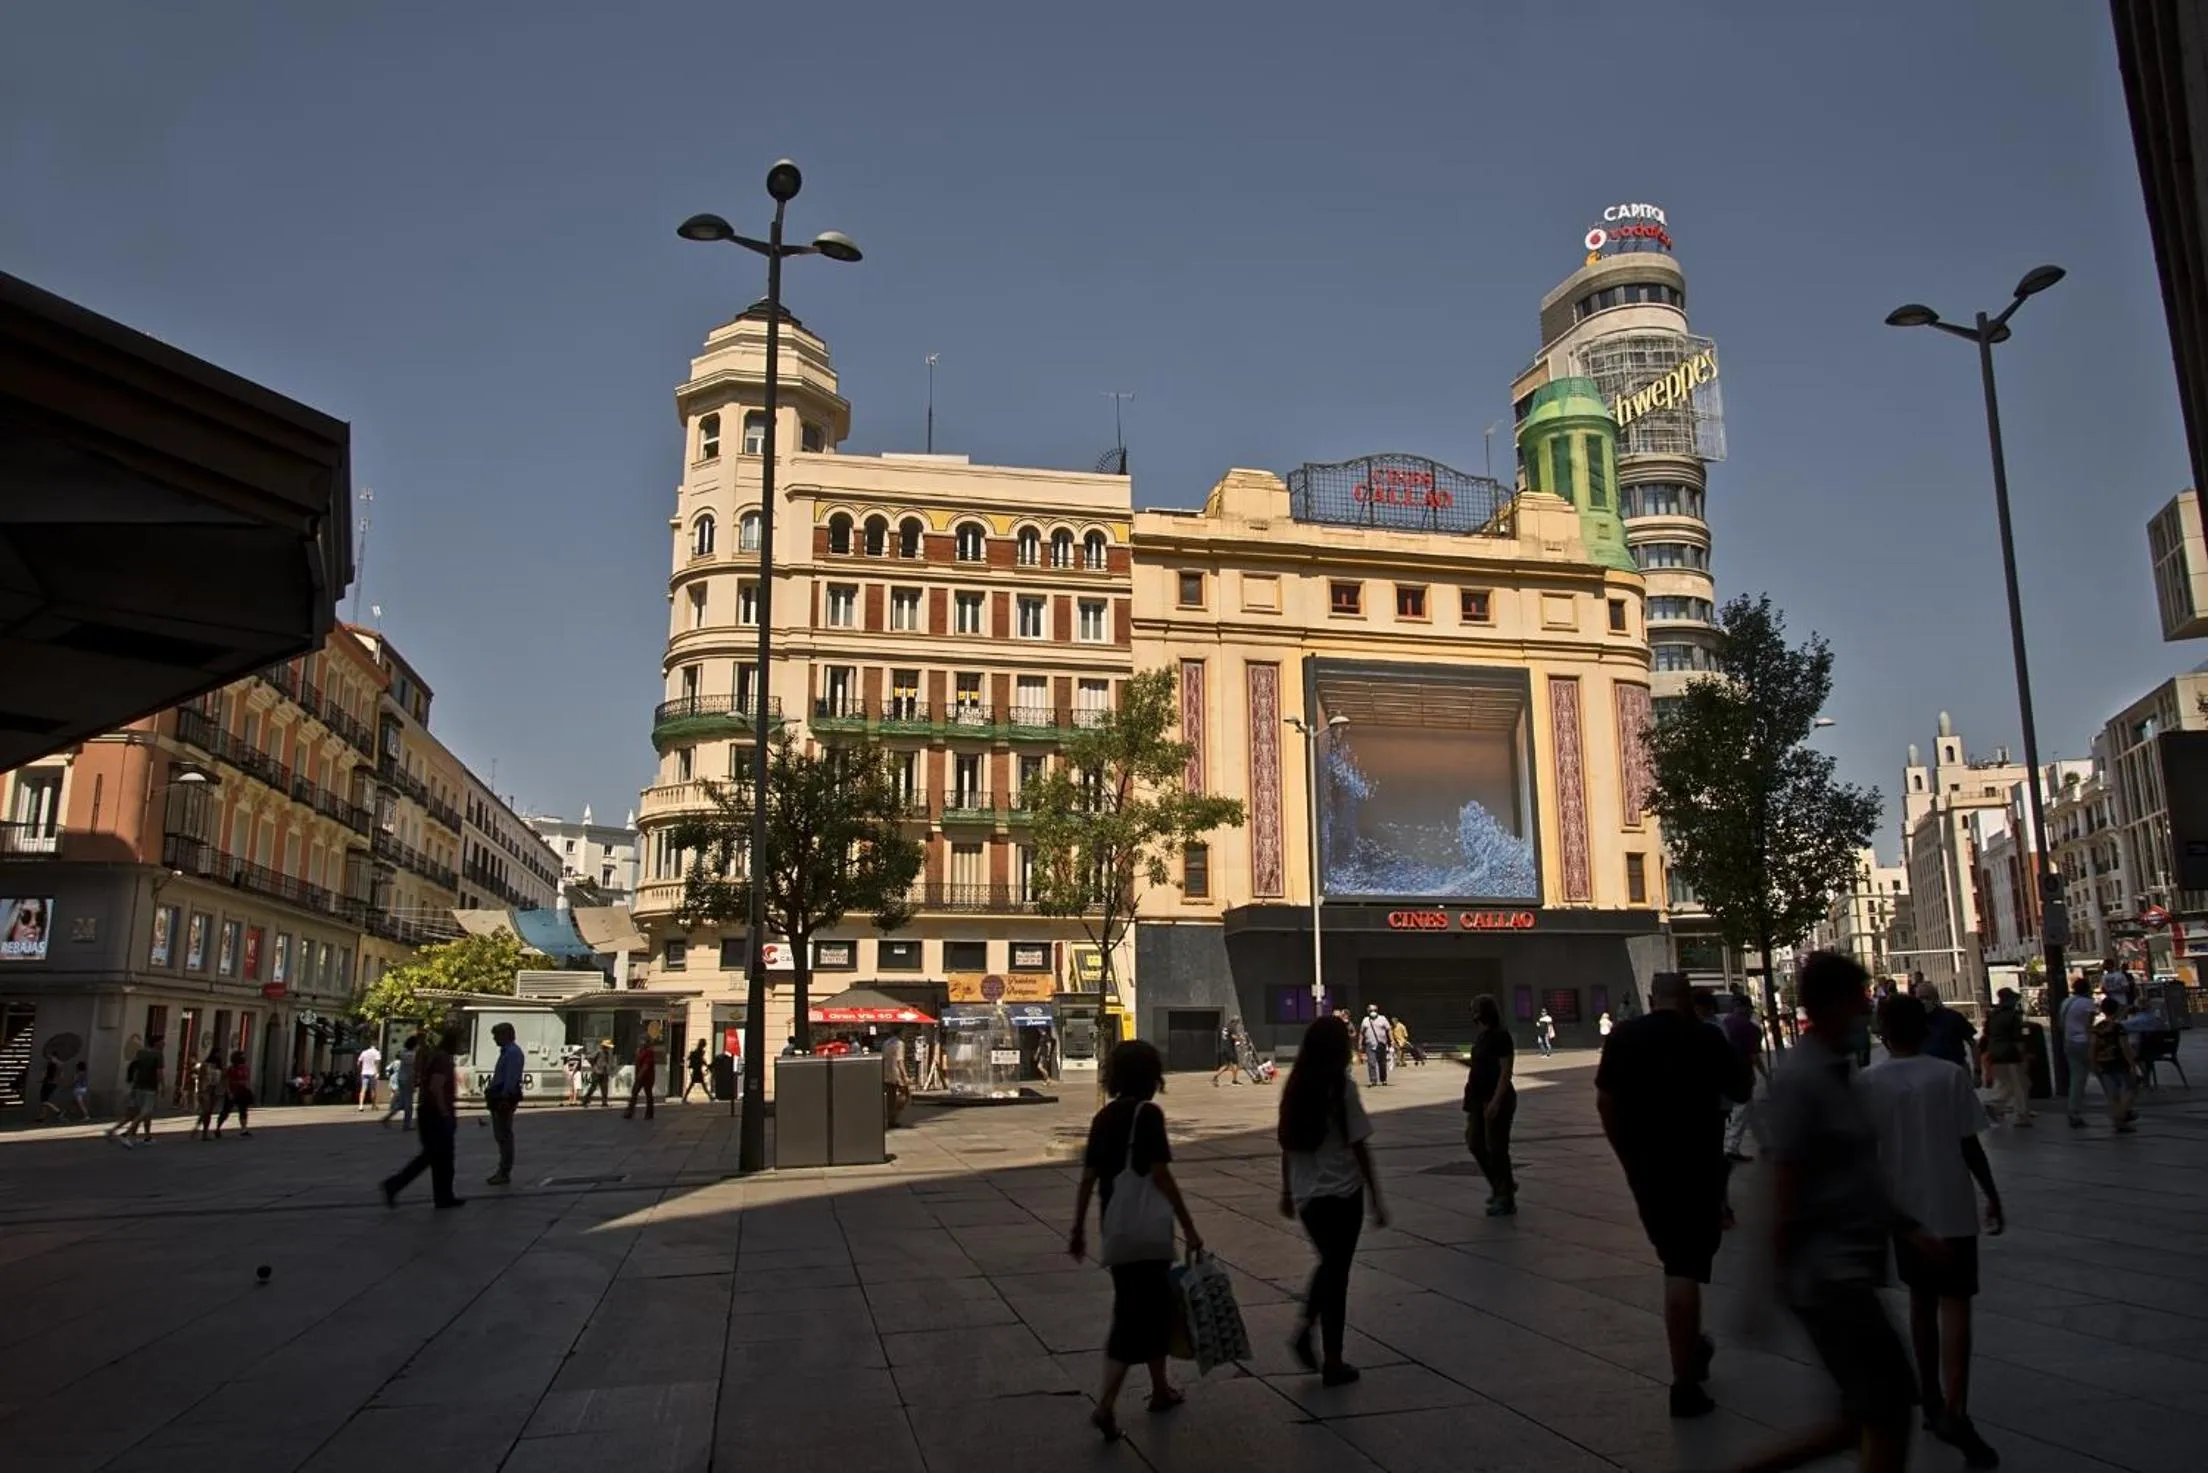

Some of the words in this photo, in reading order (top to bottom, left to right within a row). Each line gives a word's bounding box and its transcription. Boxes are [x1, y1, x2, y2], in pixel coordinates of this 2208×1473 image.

[1604, 203, 1667, 226] CAPITOL
[1609, 348, 1718, 427] hweppes
[1353, 483, 1453, 507] CALLAO
[1388, 911, 1449, 928] CINES
[1460, 911, 1535, 928] CALLAO
[0, 940, 46, 954] REBAJAS
